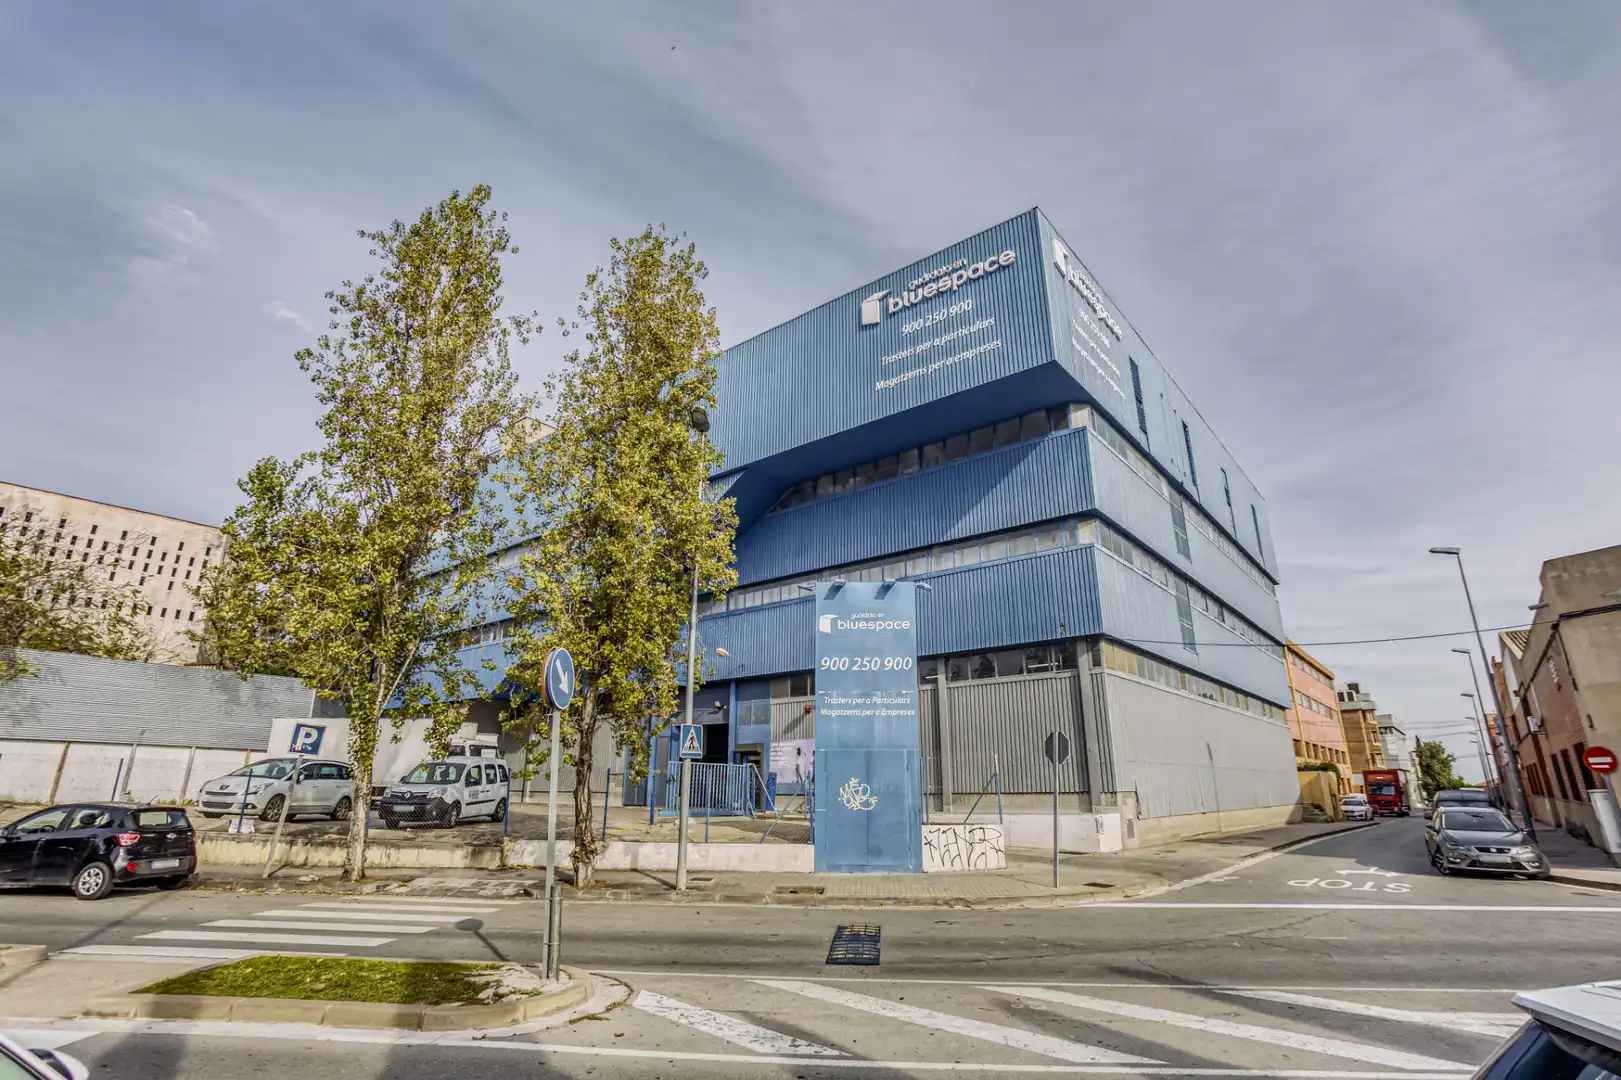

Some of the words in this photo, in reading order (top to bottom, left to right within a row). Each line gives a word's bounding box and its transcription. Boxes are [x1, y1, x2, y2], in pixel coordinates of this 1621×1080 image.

[889, 249, 1016, 314] bluespace
[902, 319, 923, 336] 900
[925, 309, 947, 327] 250
[949, 299, 972, 317] 900
[881, 347, 915, 365] Trasters
[916, 340, 932, 354] per
[933, 336, 940, 346] a
[941, 317, 995, 345] particulars
[875, 366, 927, 391] Magatzems
[928, 358, 944, 374] per
[946, 357, 953, 366] a
[954, 339, 1001, 362] empreses
[837, 619, 911, 632] bluespace
[821, 656, 848, 671] 900
[851, 656, 880, 671] 250
[884, 656, 912, 671] 900
[824, 696, 852, 705] Trasters
[852, 698, 866, 706] per
[872, 696, 911, 705] Particulars
[820, 707, 860, 718] Magatzems
[861, 709, 875, 717] per
[881, 707, 915, 718] Empreses
[296, 726, 318, 751] P
[1287, 878, 1412, 893] STOP
